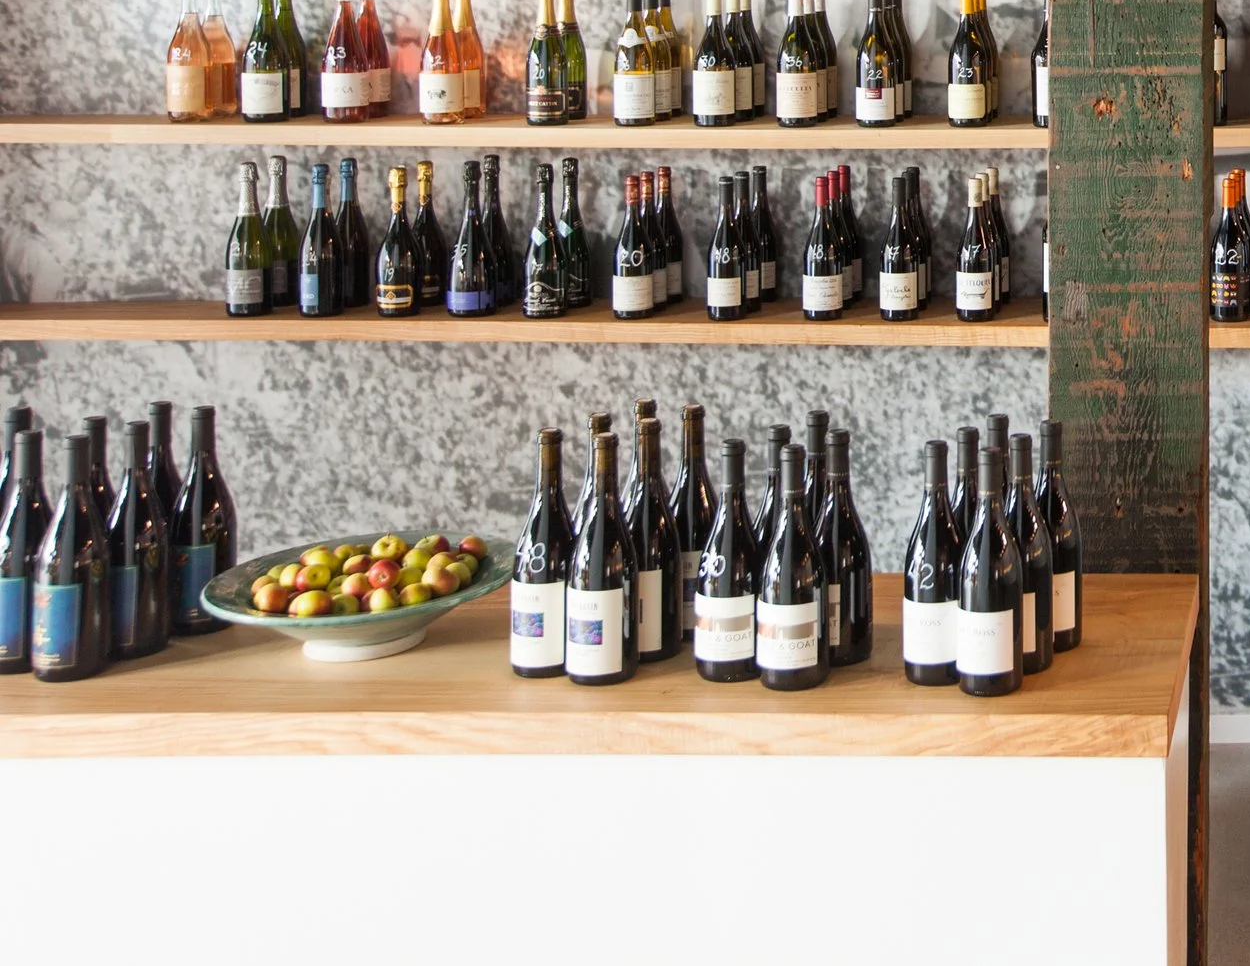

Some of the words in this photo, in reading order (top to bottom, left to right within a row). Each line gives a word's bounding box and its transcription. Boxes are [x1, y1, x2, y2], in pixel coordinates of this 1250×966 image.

[249, 42, 268, 59] 24
[866, 69, 884, 80] 22
[957, 67, 974, 78] 23
[620, 249, 644, 267] 20
[384, 267, 394, 282] 19
